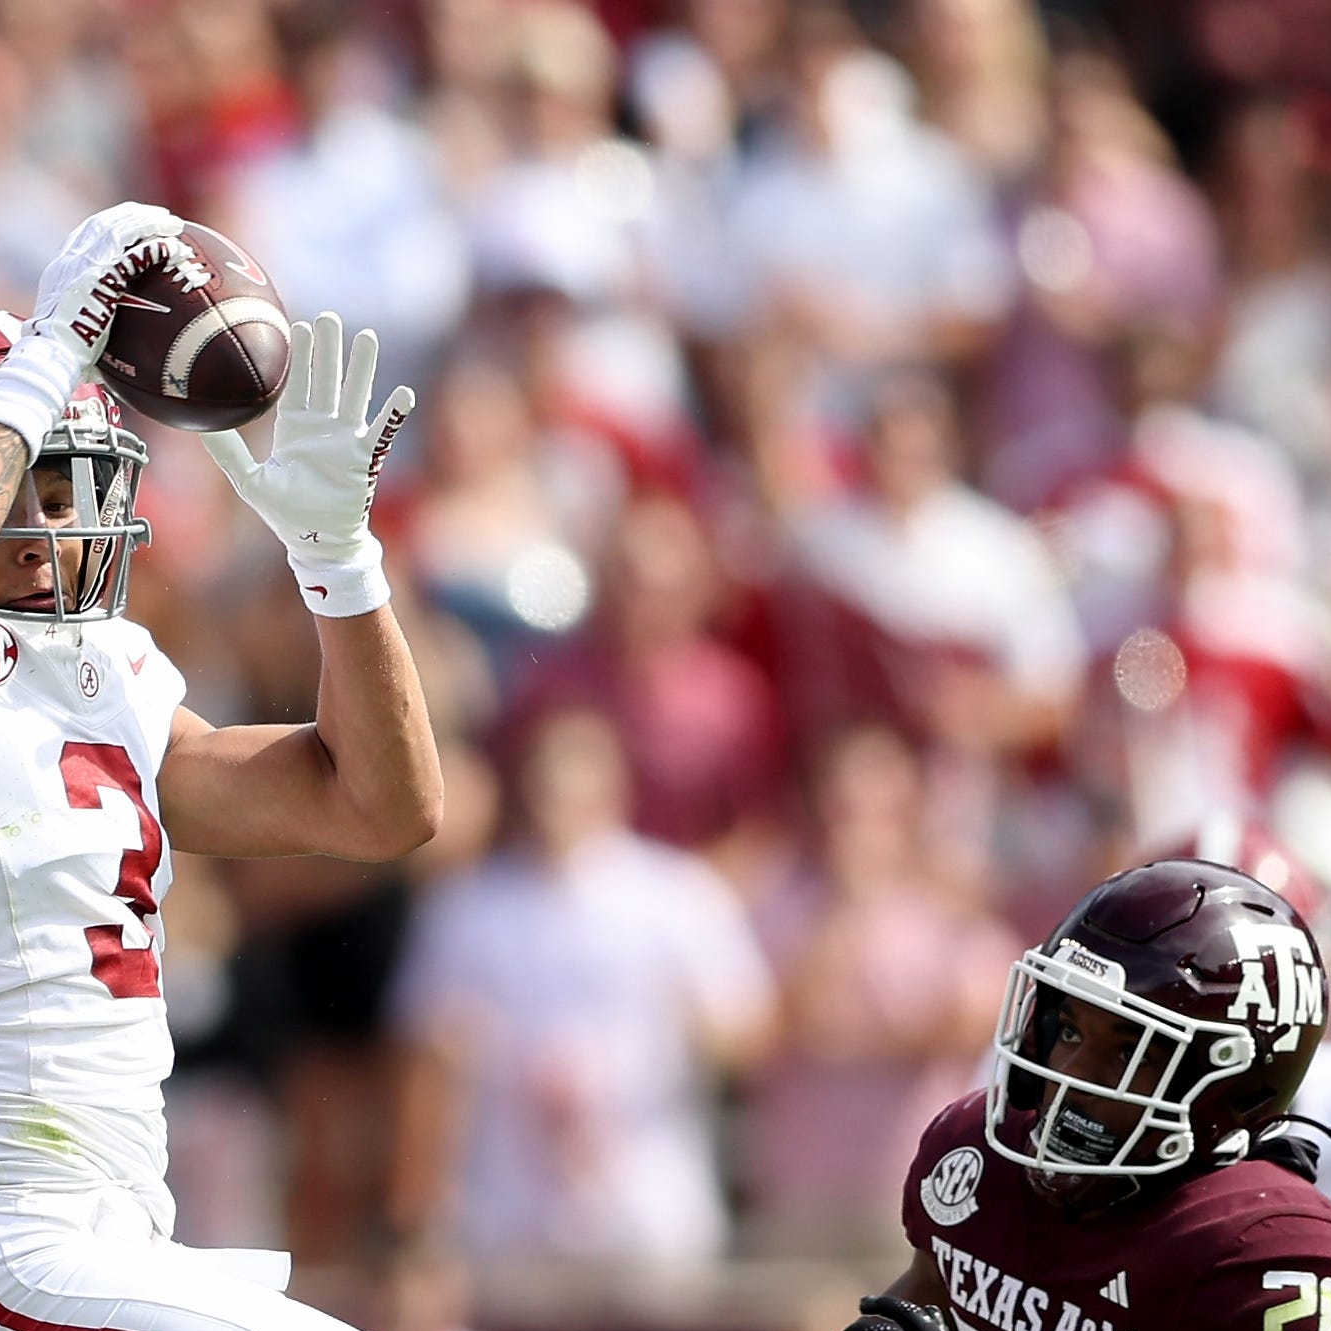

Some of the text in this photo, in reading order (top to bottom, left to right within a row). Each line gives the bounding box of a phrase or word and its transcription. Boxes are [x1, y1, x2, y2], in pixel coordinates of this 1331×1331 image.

[93, 499, 117, 554] CRSON
[59, 741, 162, 999] 3
[933, 1150, 980, 1206] SEC
